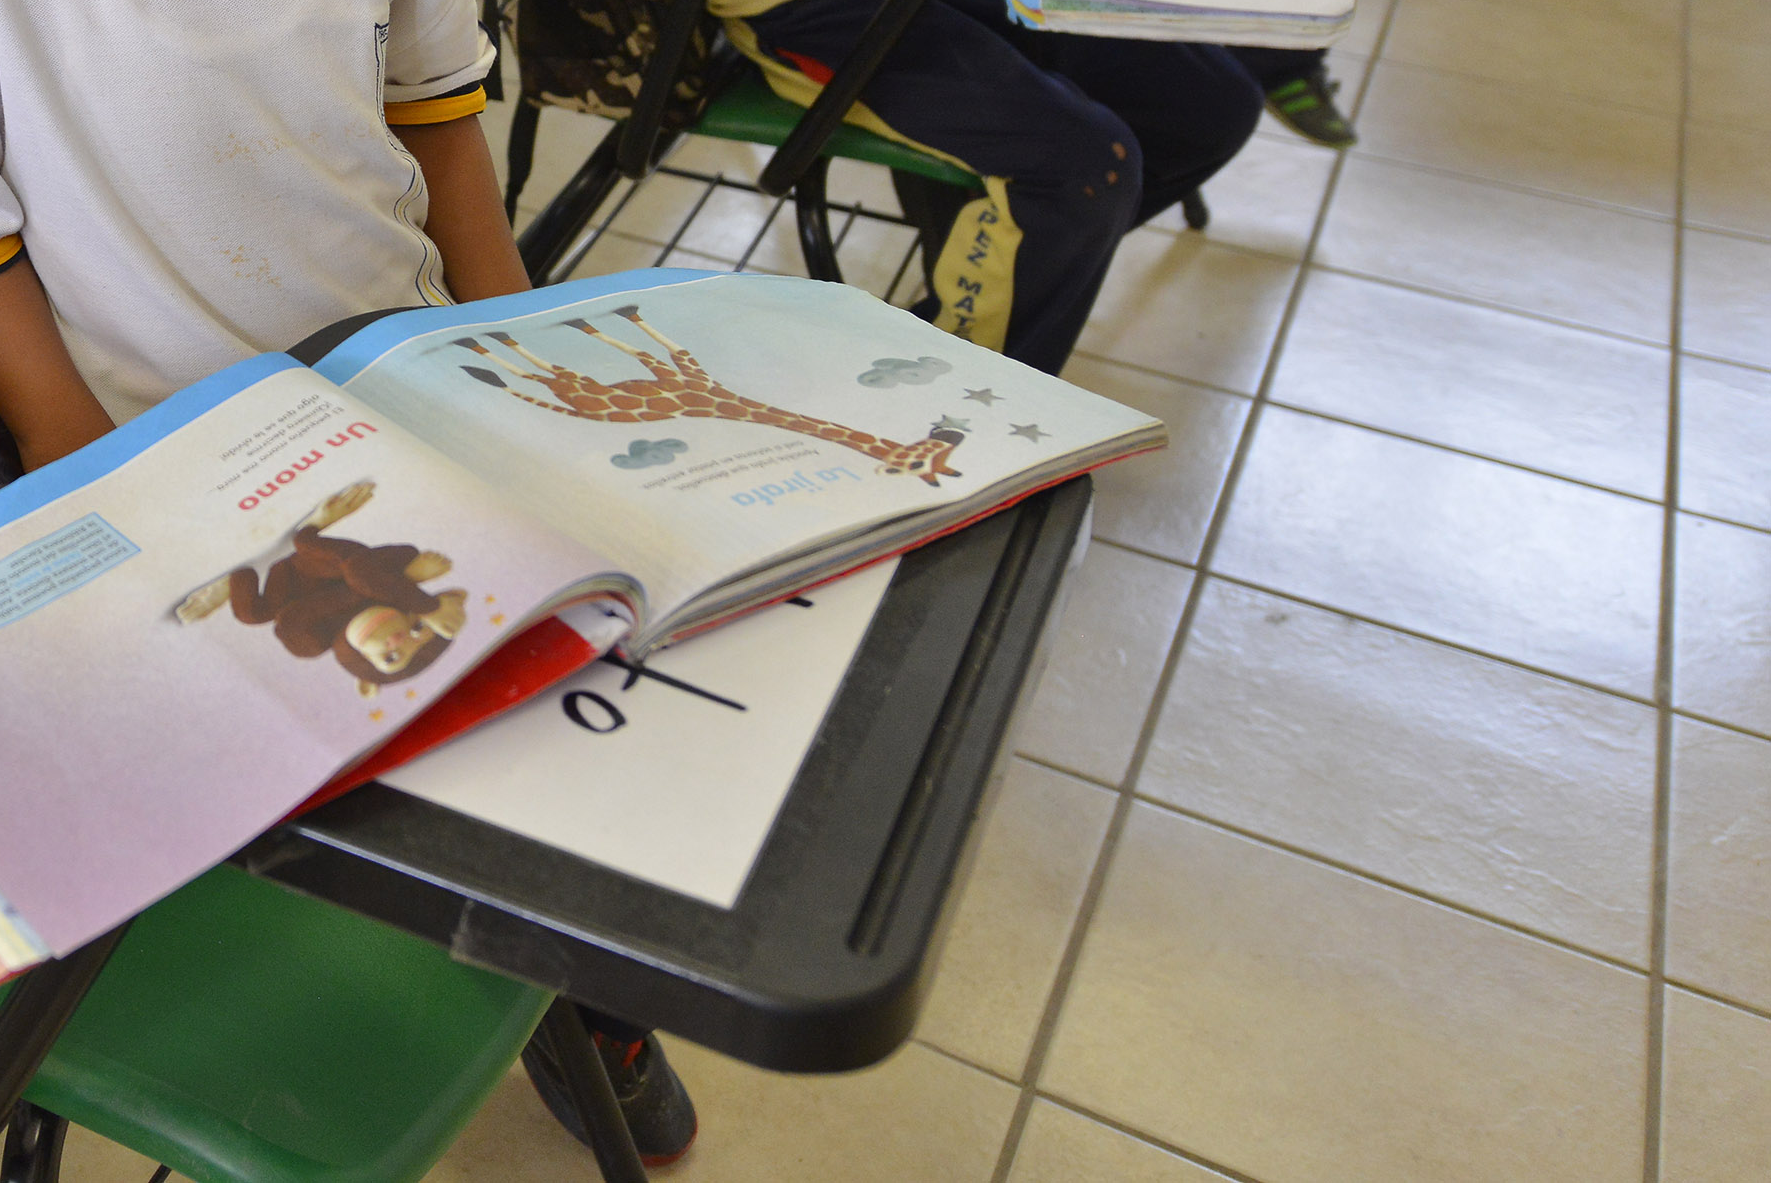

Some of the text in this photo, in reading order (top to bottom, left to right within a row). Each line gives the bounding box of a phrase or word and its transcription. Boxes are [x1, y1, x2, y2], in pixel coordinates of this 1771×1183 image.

[295, 390, 320, 412] algo
[237, 421, 378, 510] Un mono
[729, 465, 862, 507] La jirafa
